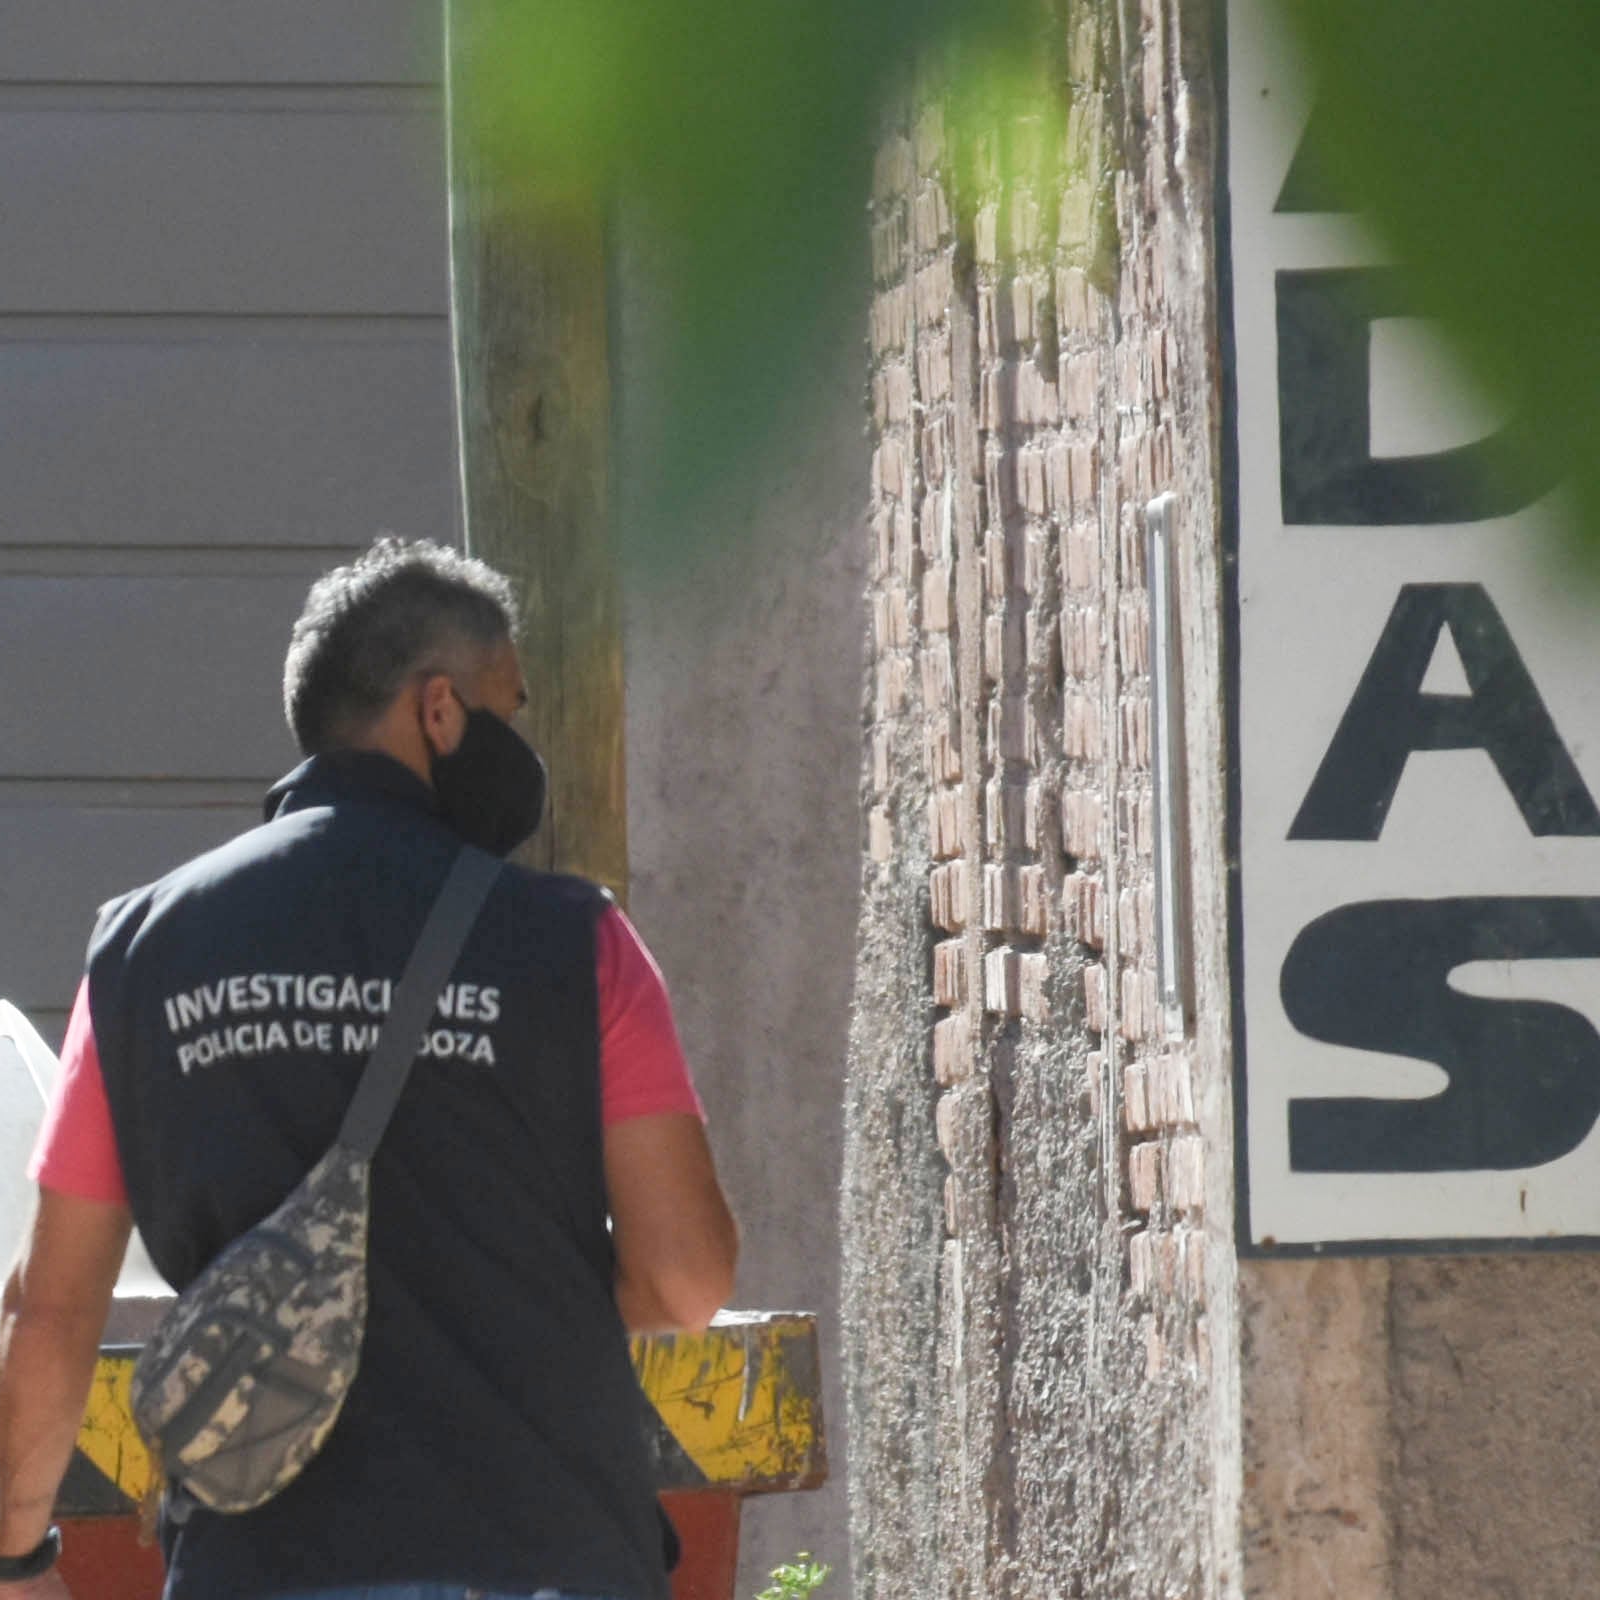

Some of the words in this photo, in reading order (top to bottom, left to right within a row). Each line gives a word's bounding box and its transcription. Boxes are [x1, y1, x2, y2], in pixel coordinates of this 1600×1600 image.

[1273, 105, 1600, 1172] DAS
[164, 973, 500, 1033] INVESTIGACINES
[177, 1020, 288, 1074] POLICIA
[294, 1018, 333, 1051] DE
[343, 1023, 496, 1065] MOZA
